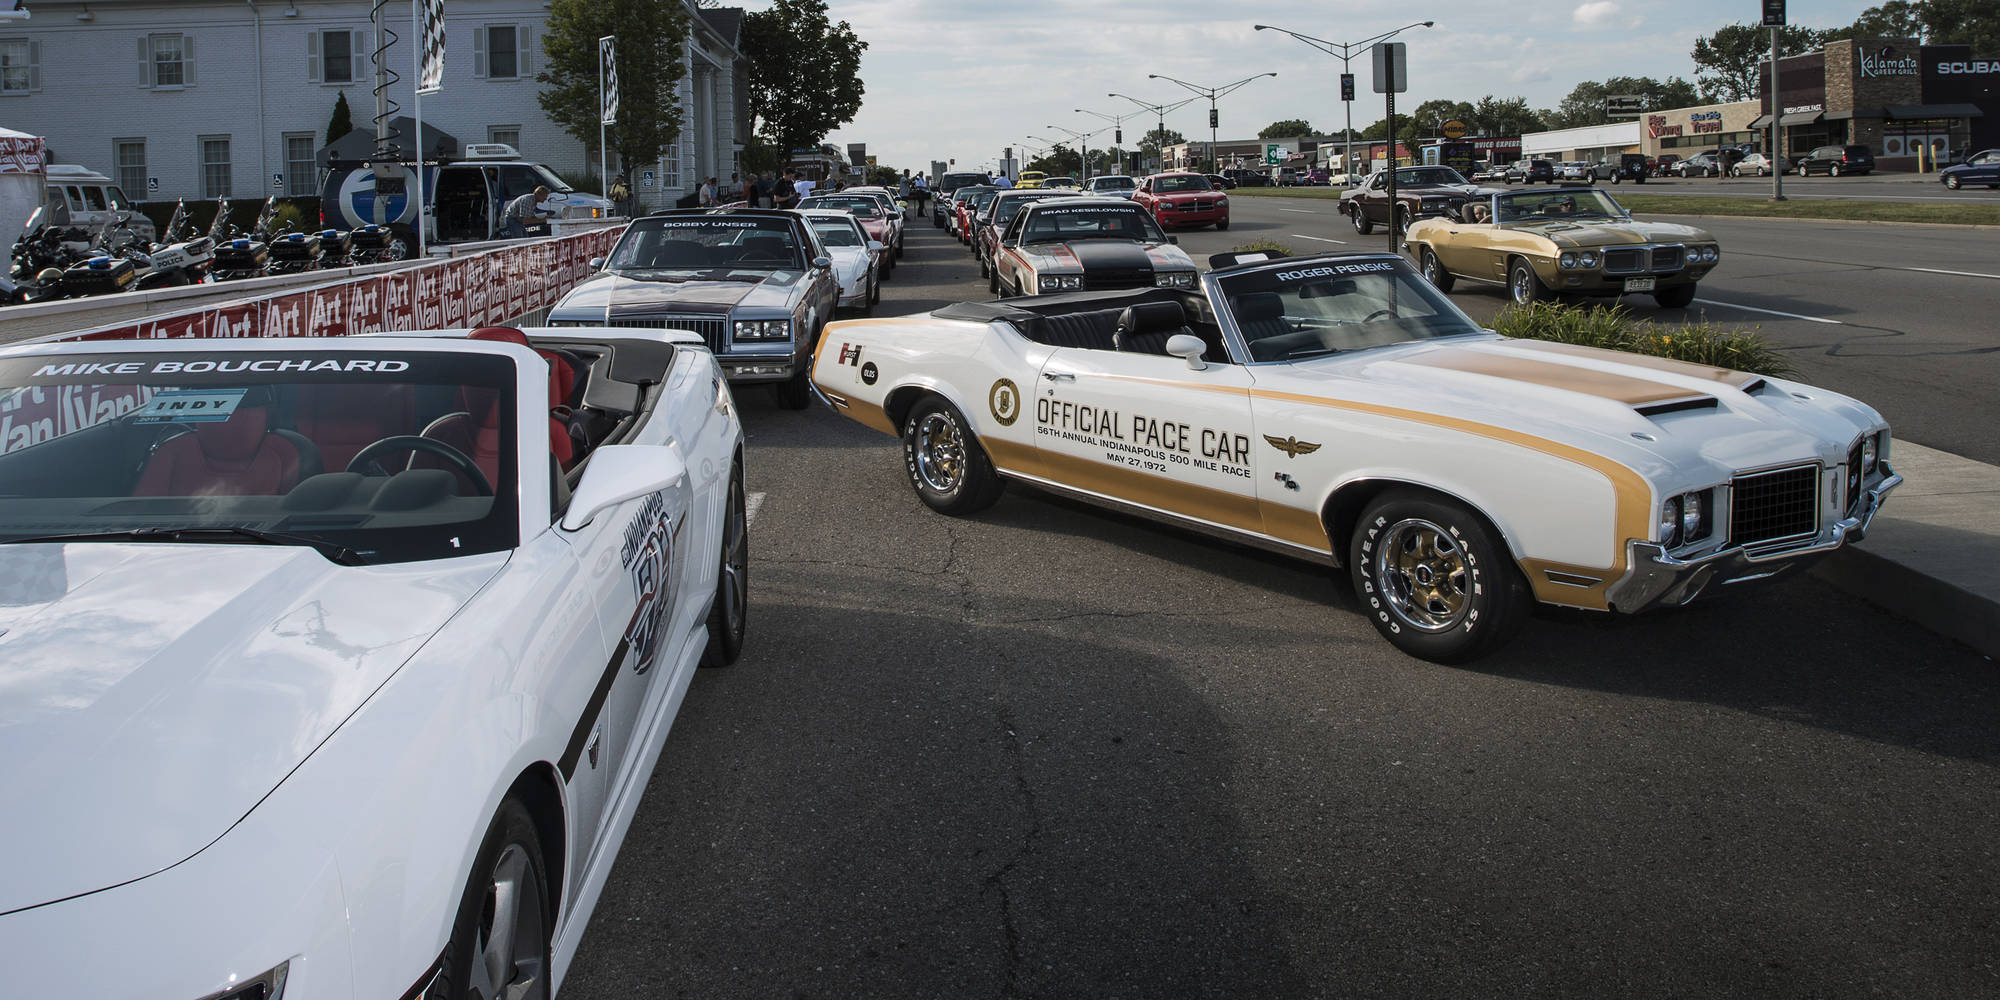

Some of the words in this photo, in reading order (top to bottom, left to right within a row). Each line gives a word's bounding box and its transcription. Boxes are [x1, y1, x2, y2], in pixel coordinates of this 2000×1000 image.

[1859, 47, 1918, 78] Kalamata
[1938, 61, 2000, 74] SCUBA
[1691, 120, 1722, 133] Travel
[1475, 141, 1494, 149] RVICE
[157, 256, 184, 268] POLICE
[1276, 267, 1336, 281] ROGER
[1335, 262, 1394, 274] PENSKE
[418, 271, 437, 301] Art
[445, 265, 461, 293] Art
[353, 284, 378, 319] Art
[388, 277, 409, 310] Art
[469, 287, 486, 312] Van
[268, 302, 300, 337] Art
[314, 292, 342, 329] Art
[418, 301, 439, 329] Van
[445, 294, 464, 320] Van
[388, 310, 412, 333] Van
[32, 361, 145, 377] MIKE
[151, 359, 409, 374] BOUCHARD
[156, 400, 227, 410] INDY
[1037, 398, 1123, 440] OFFICIAL
[1133, 415, 1191, 453] PACE
[1201, 429, 1250, 466] CAR
[1037, 426, 1060, 439] 56TH
[1062, 431, 1097, 447] ANNUAL
[1099, 438, 1166, 461] INDIANAPOLIS
[1169, 453, 1190, 467] 500
[1193, 459, 1218, 472] MILE
[1222, 465, 1251, 479] RACE
[1106, 452, 1126, 465] MAY
[450, 537, 460, 548] 1
[1450, 525, 1482, 596] EAGLE
[1360, 516, 1401, 634] GOODYEAR
[1464, 608, 1479, 633] ST
